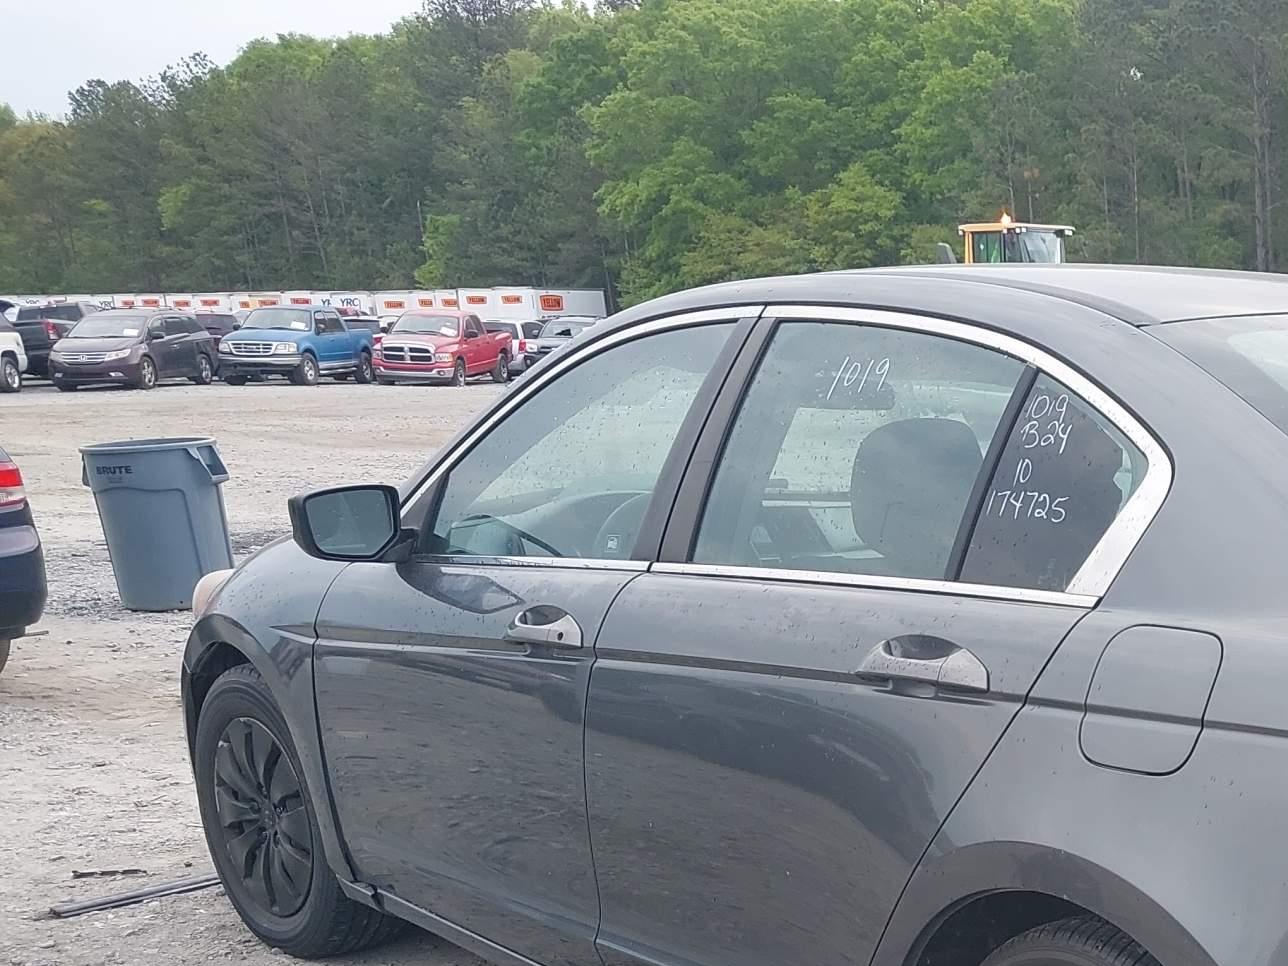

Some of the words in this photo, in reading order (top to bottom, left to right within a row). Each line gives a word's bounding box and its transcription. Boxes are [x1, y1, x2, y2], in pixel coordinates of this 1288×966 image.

[340, 298, 359, 307] YRC
[826, 356, 890, 400] 1019
[1025, 394, 1069, 423] 1019
[1020, 420, 1073, 455] B24
[96, 465, 133, 475] BRUTE
[1013, 458, 1032, 488] 10
[986, 489, 1070, 523] 174725
